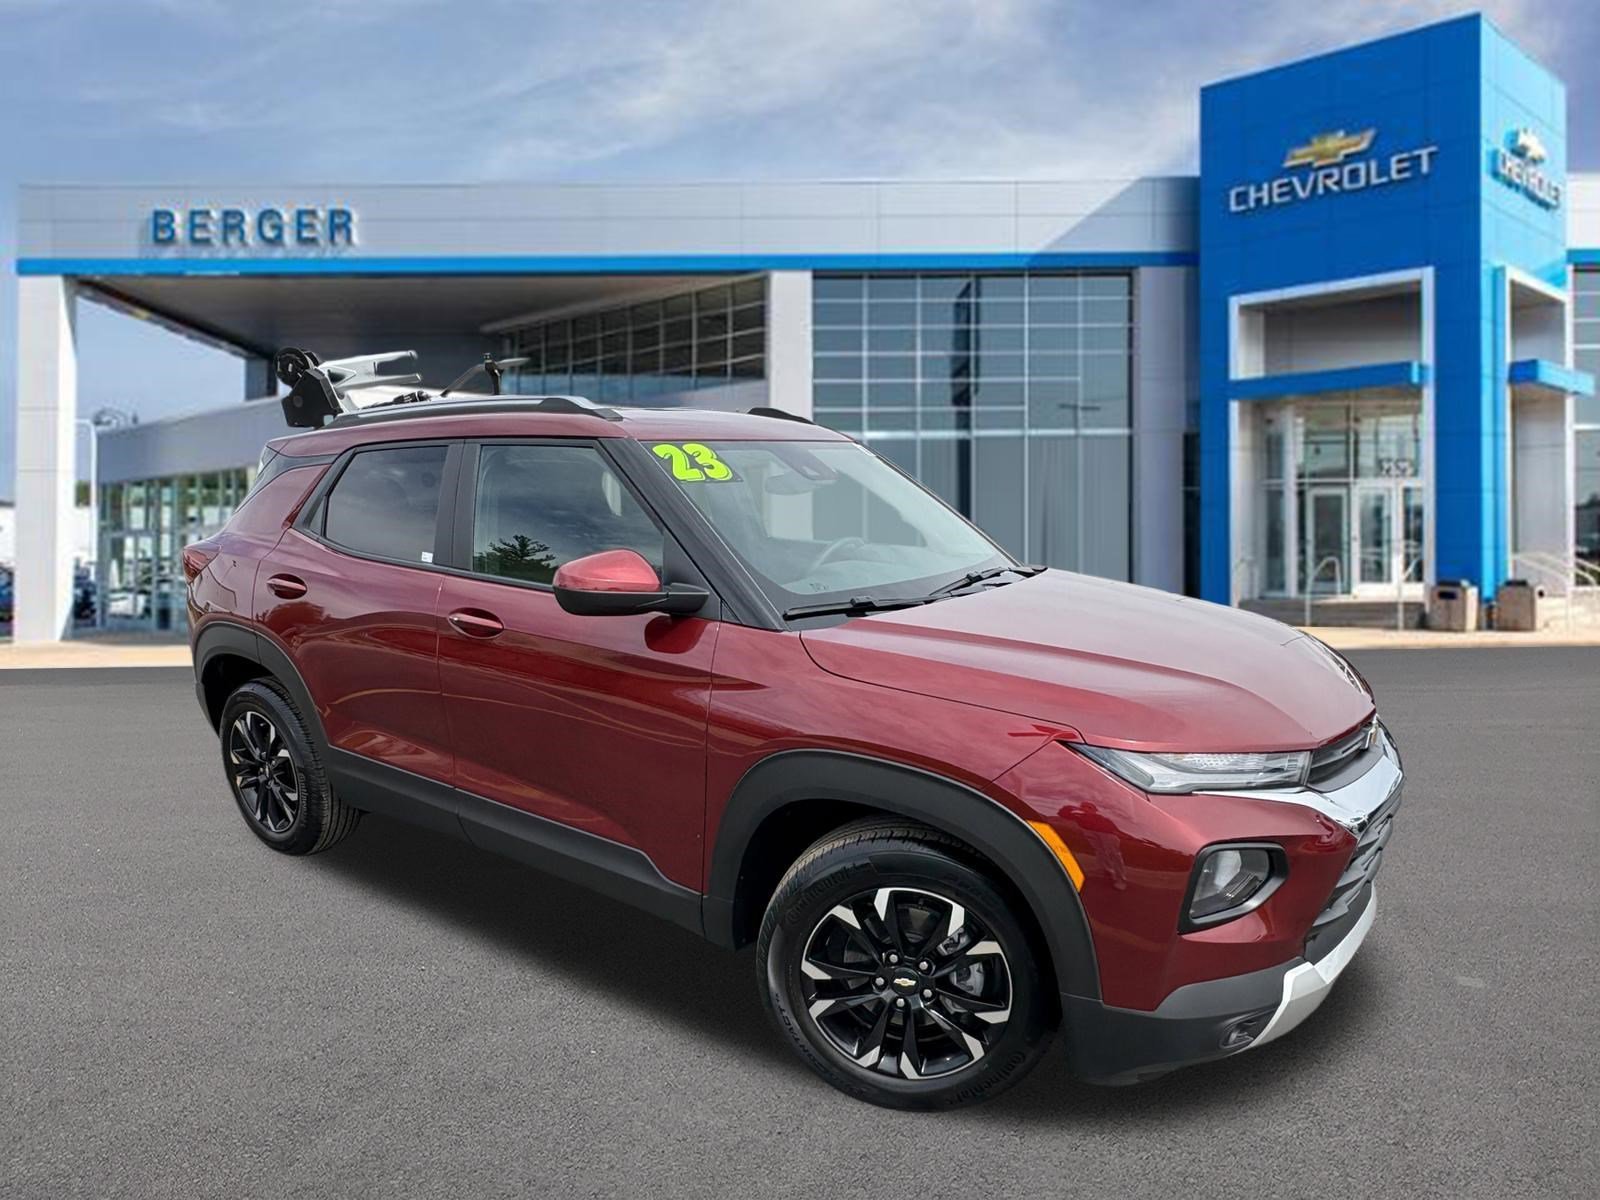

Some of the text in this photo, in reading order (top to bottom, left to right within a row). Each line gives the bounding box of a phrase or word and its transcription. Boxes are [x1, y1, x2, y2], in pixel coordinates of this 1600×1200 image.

[1229, 146, 1438, 212] CHEVROLET
[1499, 150, 1561, 210] CHEVROL
[152, 208, 354, 244] BERGER
[652, 443, 733, 482] 23
